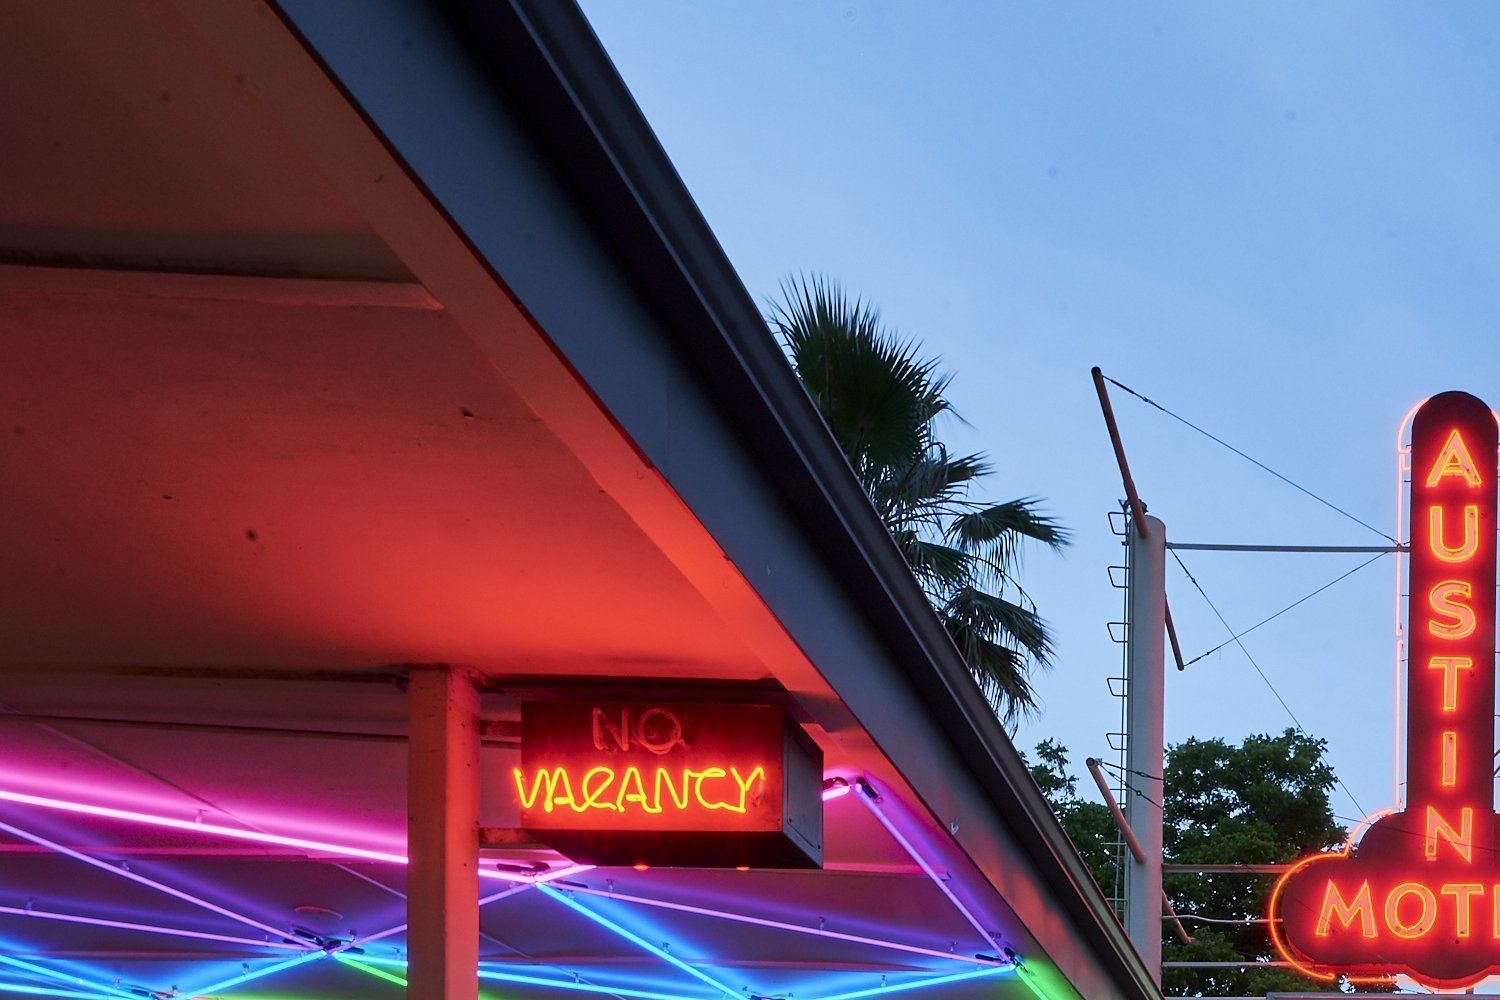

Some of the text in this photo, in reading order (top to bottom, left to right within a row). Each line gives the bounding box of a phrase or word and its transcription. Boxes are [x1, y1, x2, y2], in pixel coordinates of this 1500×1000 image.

[1426, 429, 1481, 863] AUSTIN
[592, 707, 687, 753] NO
[513, 765, 765, 814] VACANCY
